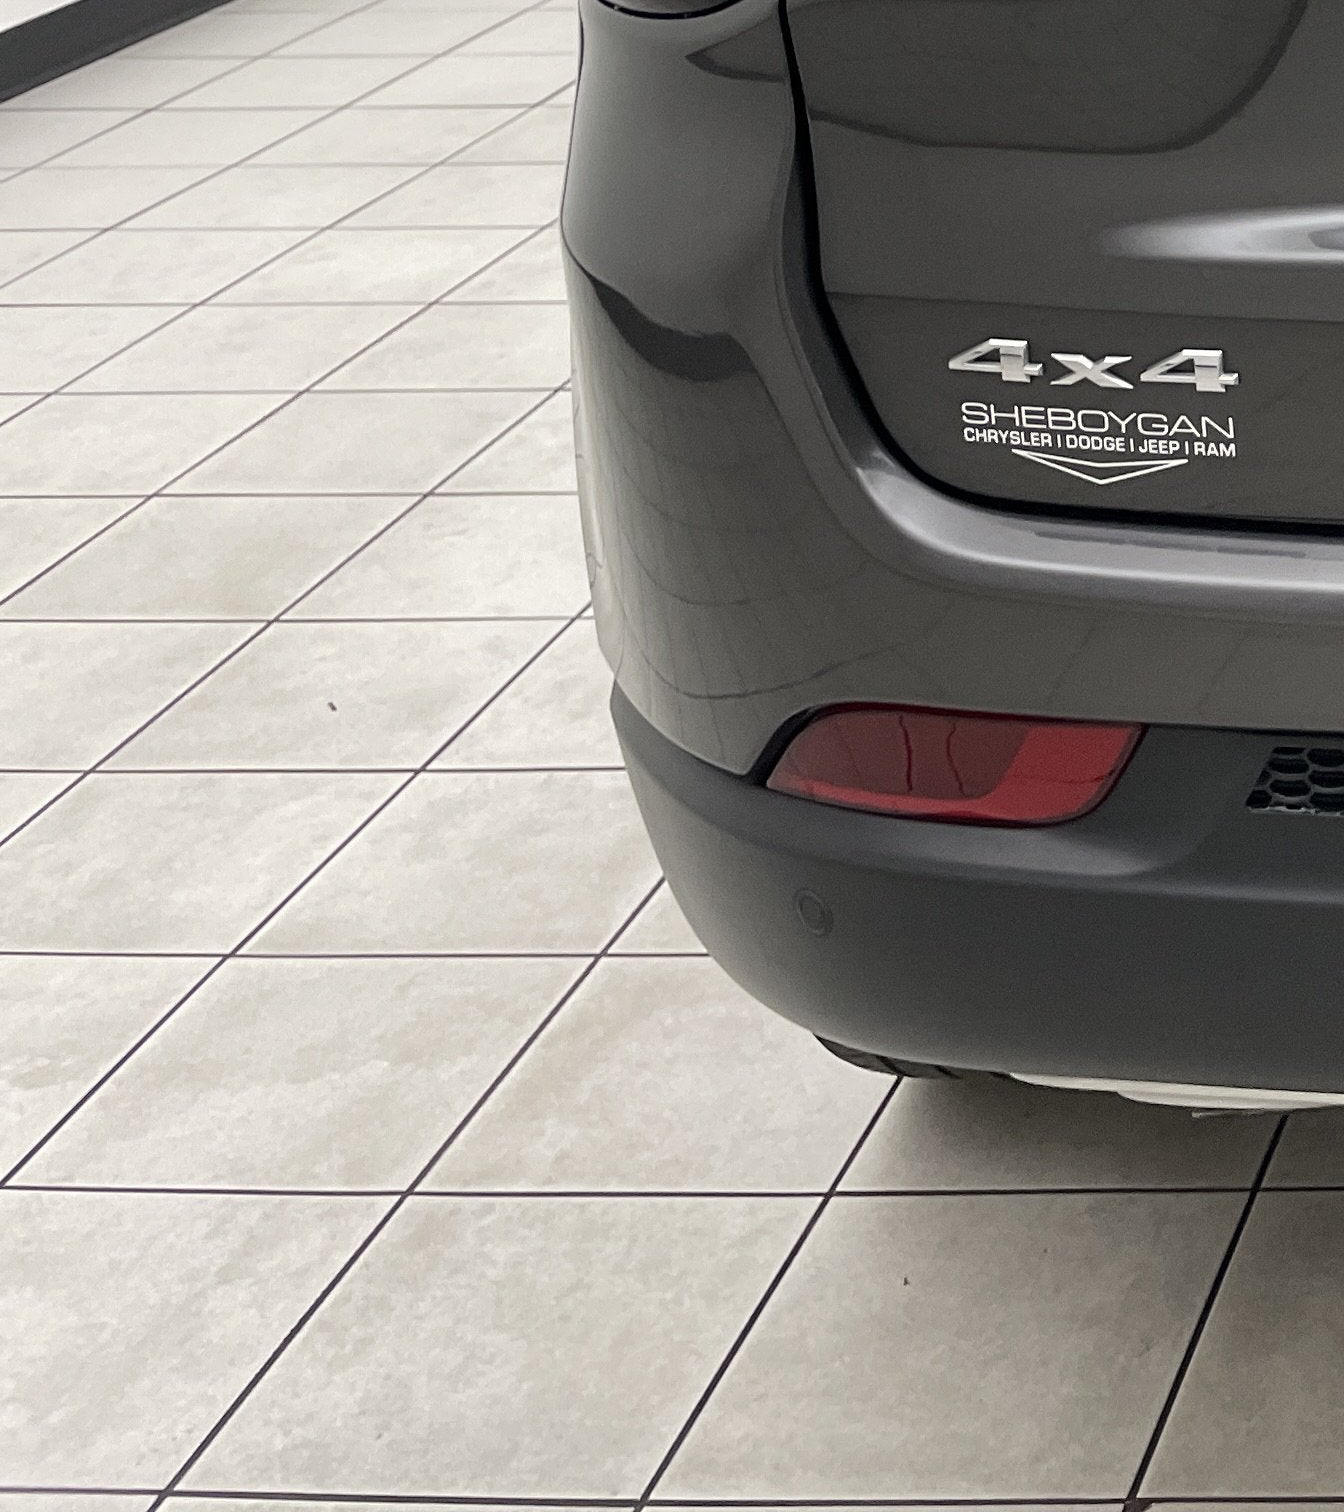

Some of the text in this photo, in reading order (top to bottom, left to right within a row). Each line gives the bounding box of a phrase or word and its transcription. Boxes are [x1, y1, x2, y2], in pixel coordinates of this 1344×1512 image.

[949, 338, 1240, 393] 4x4
[961, 402, 1235, 439] SHEBOYGAN
[963, 428, 1237, 458] CHRYSLER DODGE JEEP RAM
